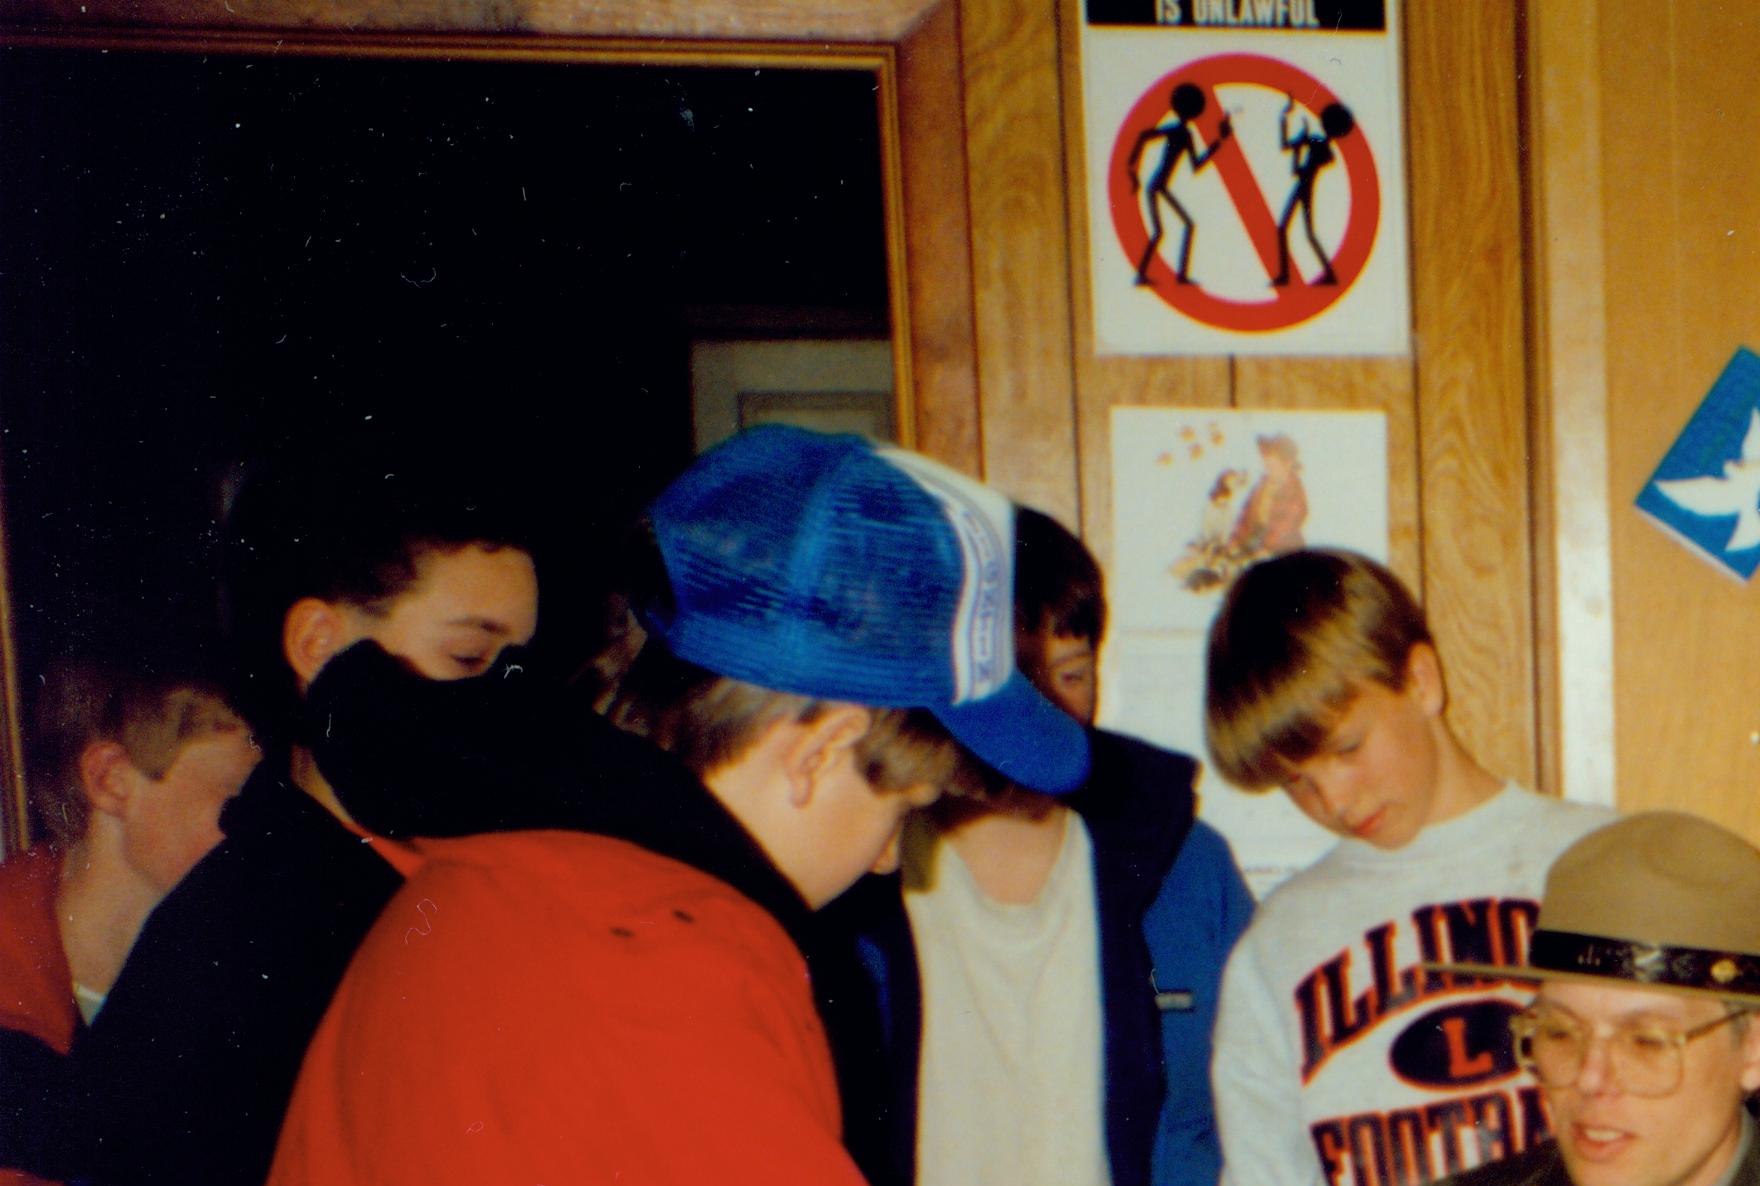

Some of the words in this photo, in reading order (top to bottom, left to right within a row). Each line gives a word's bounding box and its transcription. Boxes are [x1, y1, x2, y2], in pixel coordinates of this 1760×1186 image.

[1155, 0, 1181, 24] IS
[1192, 0, 1320, 27] UNLAWFUL
[1295, 896, 1542, 1088] ILLINO
